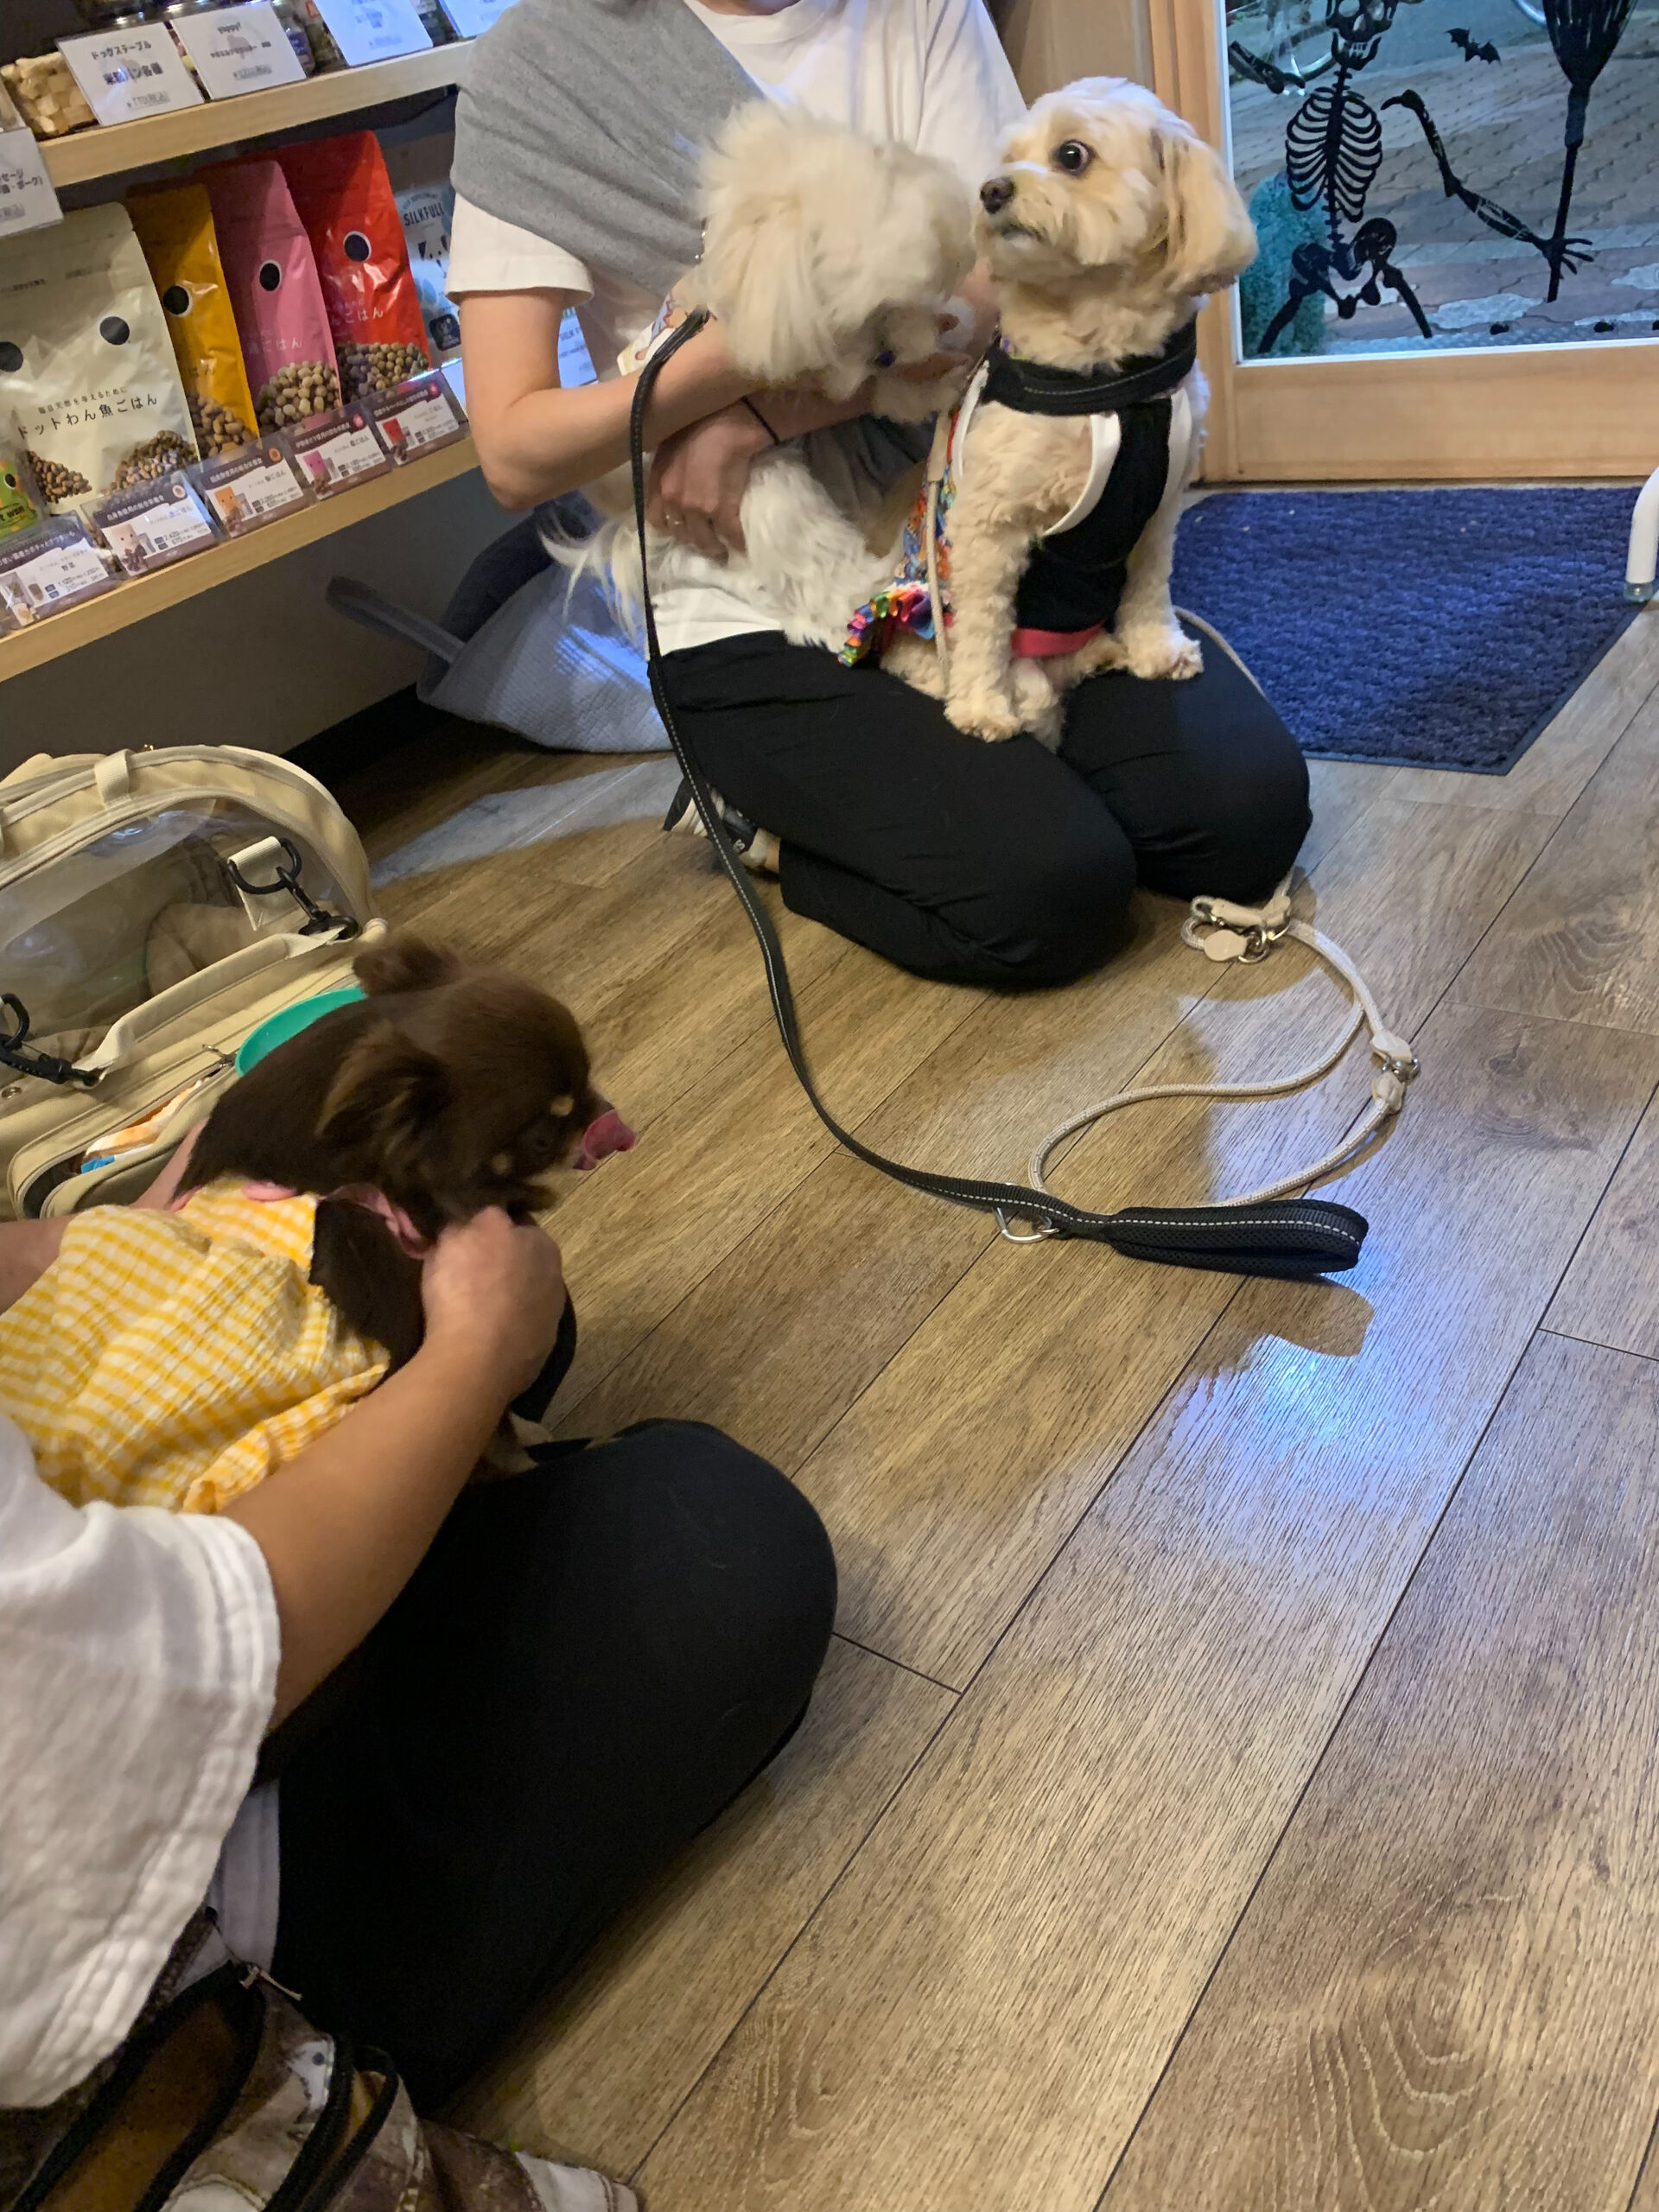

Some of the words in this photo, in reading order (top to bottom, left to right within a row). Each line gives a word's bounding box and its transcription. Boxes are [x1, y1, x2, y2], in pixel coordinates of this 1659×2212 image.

[404, 202, 445, 226] SILKFULL
[17, 394, 157, 440] ドットわん魚ごはん
